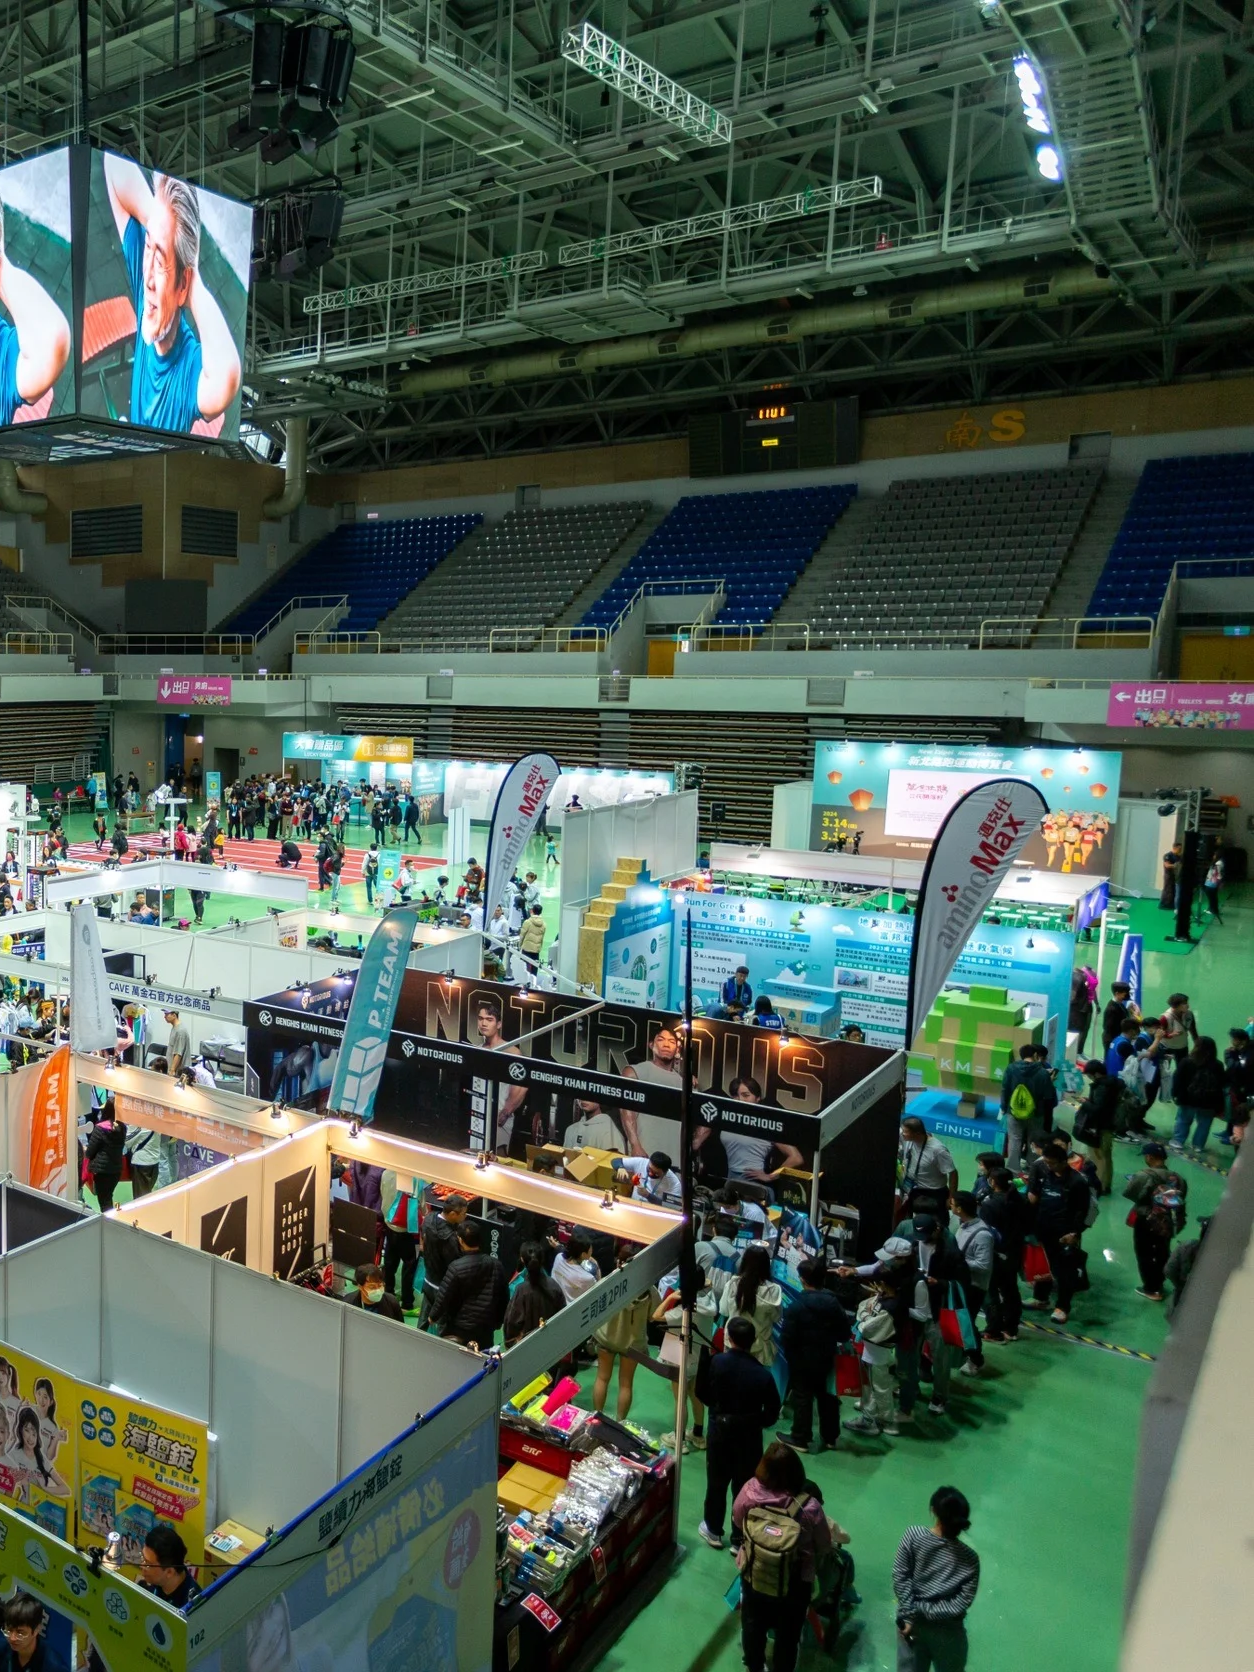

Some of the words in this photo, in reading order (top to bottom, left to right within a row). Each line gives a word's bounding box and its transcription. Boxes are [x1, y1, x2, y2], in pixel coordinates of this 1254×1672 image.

[946, 411, 983, 448] 南
[988, 409, 1026, 443] S
[172, 681, 190, 694] 出口
[1134, 689, 1166, 704] 出口
[822, 817, 848, 828] 3.14
[975, 796, 1014, 841] 邁克仕
[702, 899, 717, 908] For
[109, 981, 130, 994] CAVE
[131, 985, 211, 1012] 萬金石官方紀念商品
[275, 1016, 300, 1030] GENGHIS
[301, 1022, 319, 1033] KHAN
[318, 1026, 344, 1039] FITNESS
[417, 1045, 463, 1064] NOTORIOUS
[530, 1069, 562, 1087] GENGHIS
[563, 1075, 586, 1092] KHAN
[588, 1079, 621, 1099] FITNESS
[622, 1086, 645, 1103] CLUB
[721, 1110, 784, 1133] NOTORIOUS
[935, 1121, 983, 1140] FINISH
[183, 1143, 214, 1163] CAVE
[282, 1201, 293, 1212] TO
[282, 1207, 309, 1226] POWER
[281, 1224, 304, 1243] YOUR
[281, 1236, 308, 1257] BODY.
[122, 1423, 197, 1474] 海鹽錠
[317, 1453, 403, 1543] 鹽續力海鹽錠
[189, 1628, 205, 1649] 102
